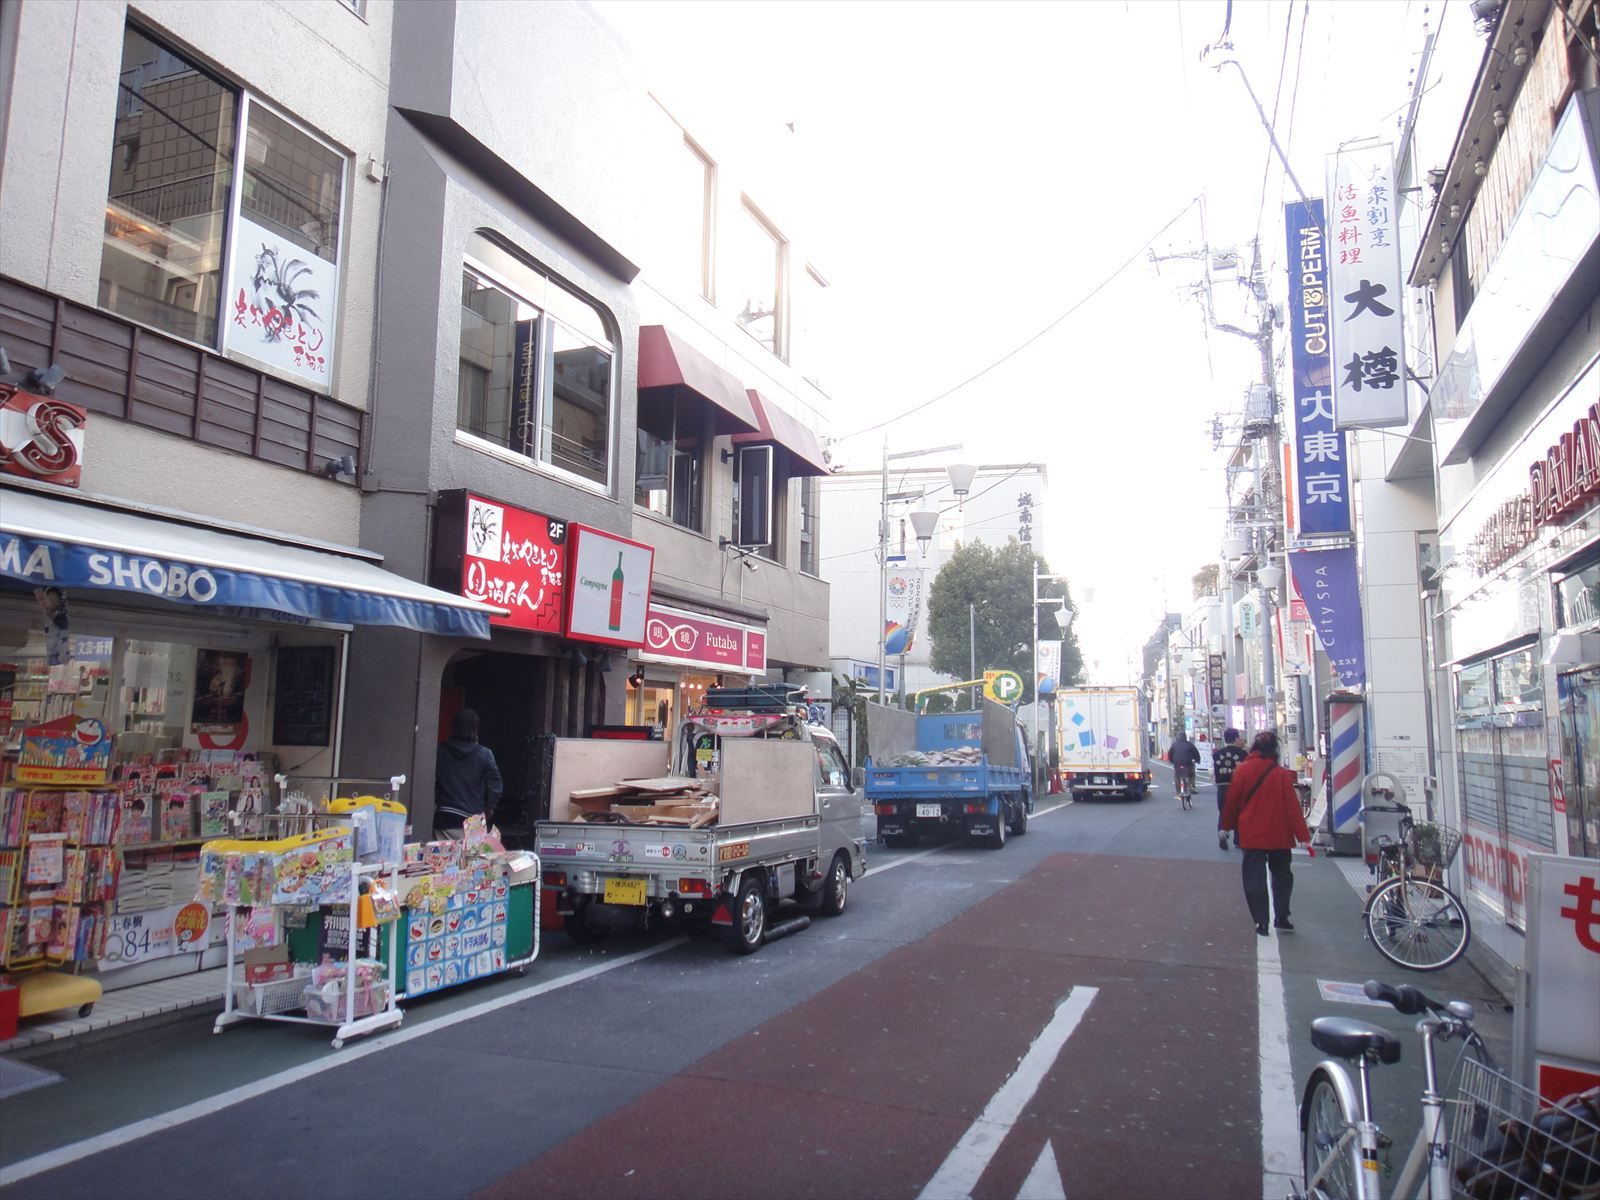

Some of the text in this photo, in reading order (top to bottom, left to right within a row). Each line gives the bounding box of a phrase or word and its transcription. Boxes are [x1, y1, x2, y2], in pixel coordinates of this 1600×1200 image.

[1338, 183, 1363, 265] 活魚料理
[1366, 164, 1391, 249] 大衆割烹
[1342, 279, 1401, 392] 大樽
[1300, 390, 1343, 504] 大東京
[549, 522, 564, 539] 2F
[88, 554, 218, 602] SHOBO
[1314, 565, 1335, 647] City SPA
[706, 631, 738, 651] Futaba
[1000, 677, 1017, 698] P
